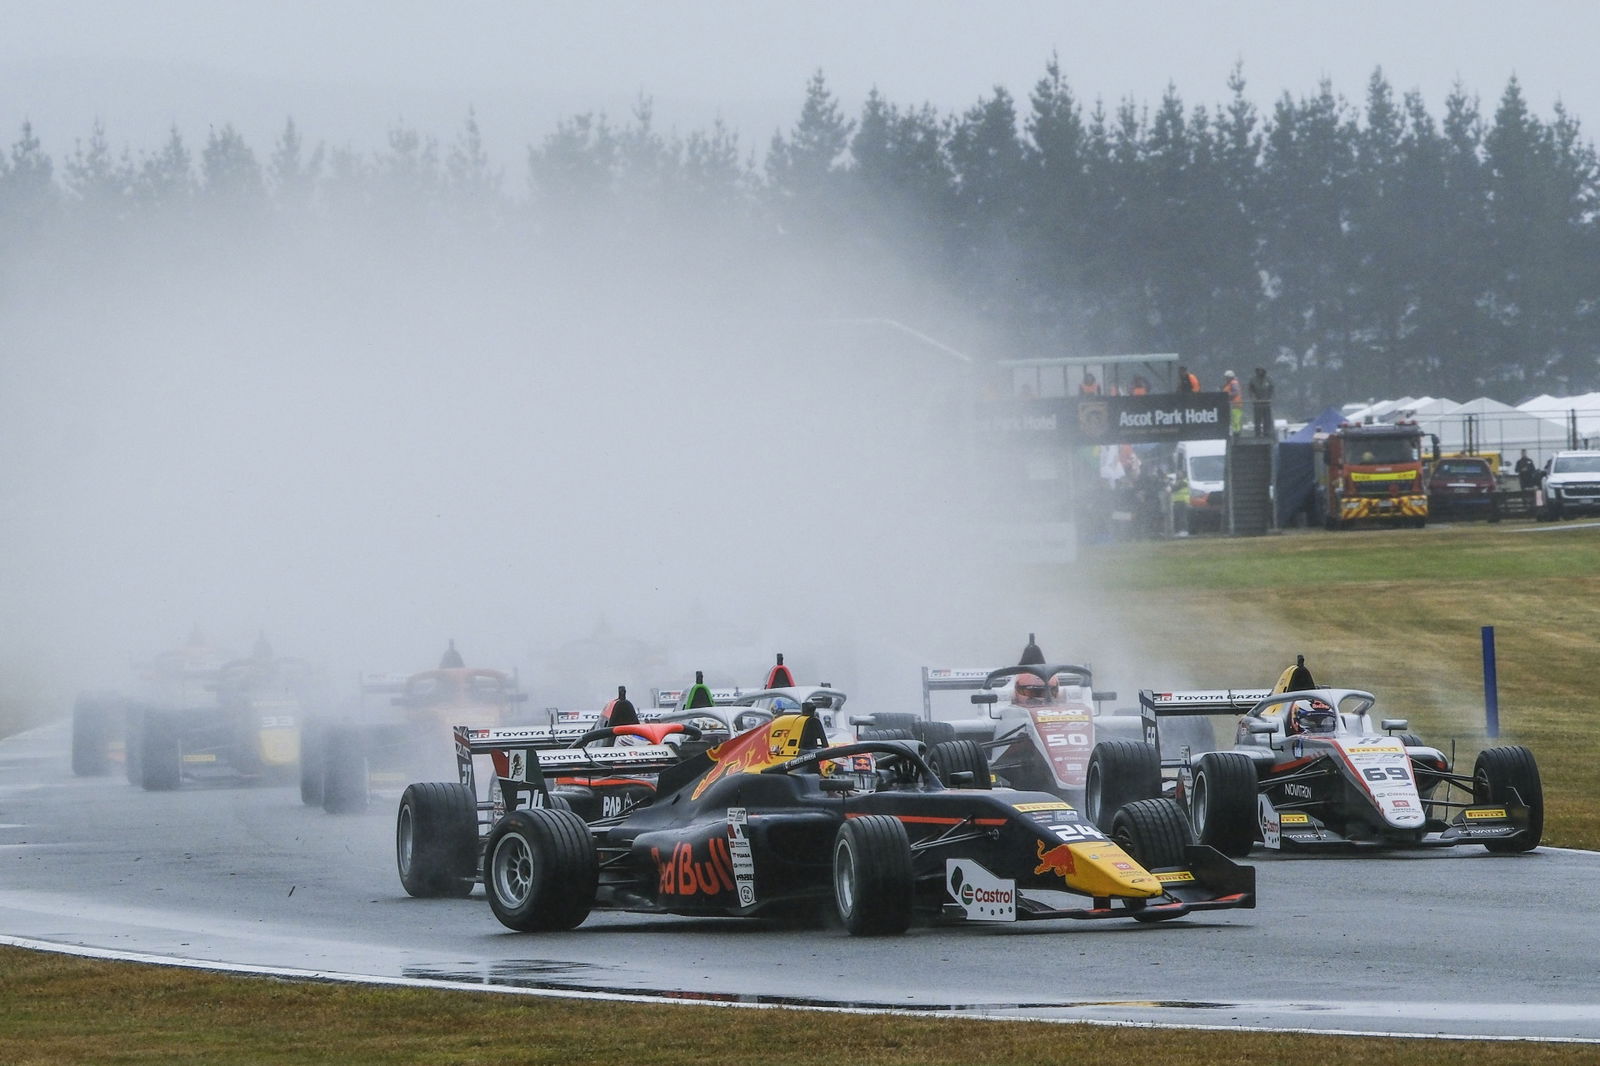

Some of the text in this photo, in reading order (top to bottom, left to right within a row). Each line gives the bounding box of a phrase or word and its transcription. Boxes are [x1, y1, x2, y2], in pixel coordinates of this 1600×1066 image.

[1120, 408, 1218, 426] Ascot Park Hotel
[493, 730, 545, 738] TOYOTA
[772, 729, 789, 737] GR
[1046, 733, 1088, 747] 50
[629, 750, 669, 761] Racing
[1362, 767, 1410, 781] 69
[1284, 783, 1312, 799] NOVATRON
[515, 789, 545, 811] 24
[1047, 824, 1105, 842] 24
[975, 888, 1013, 904] Castrol
